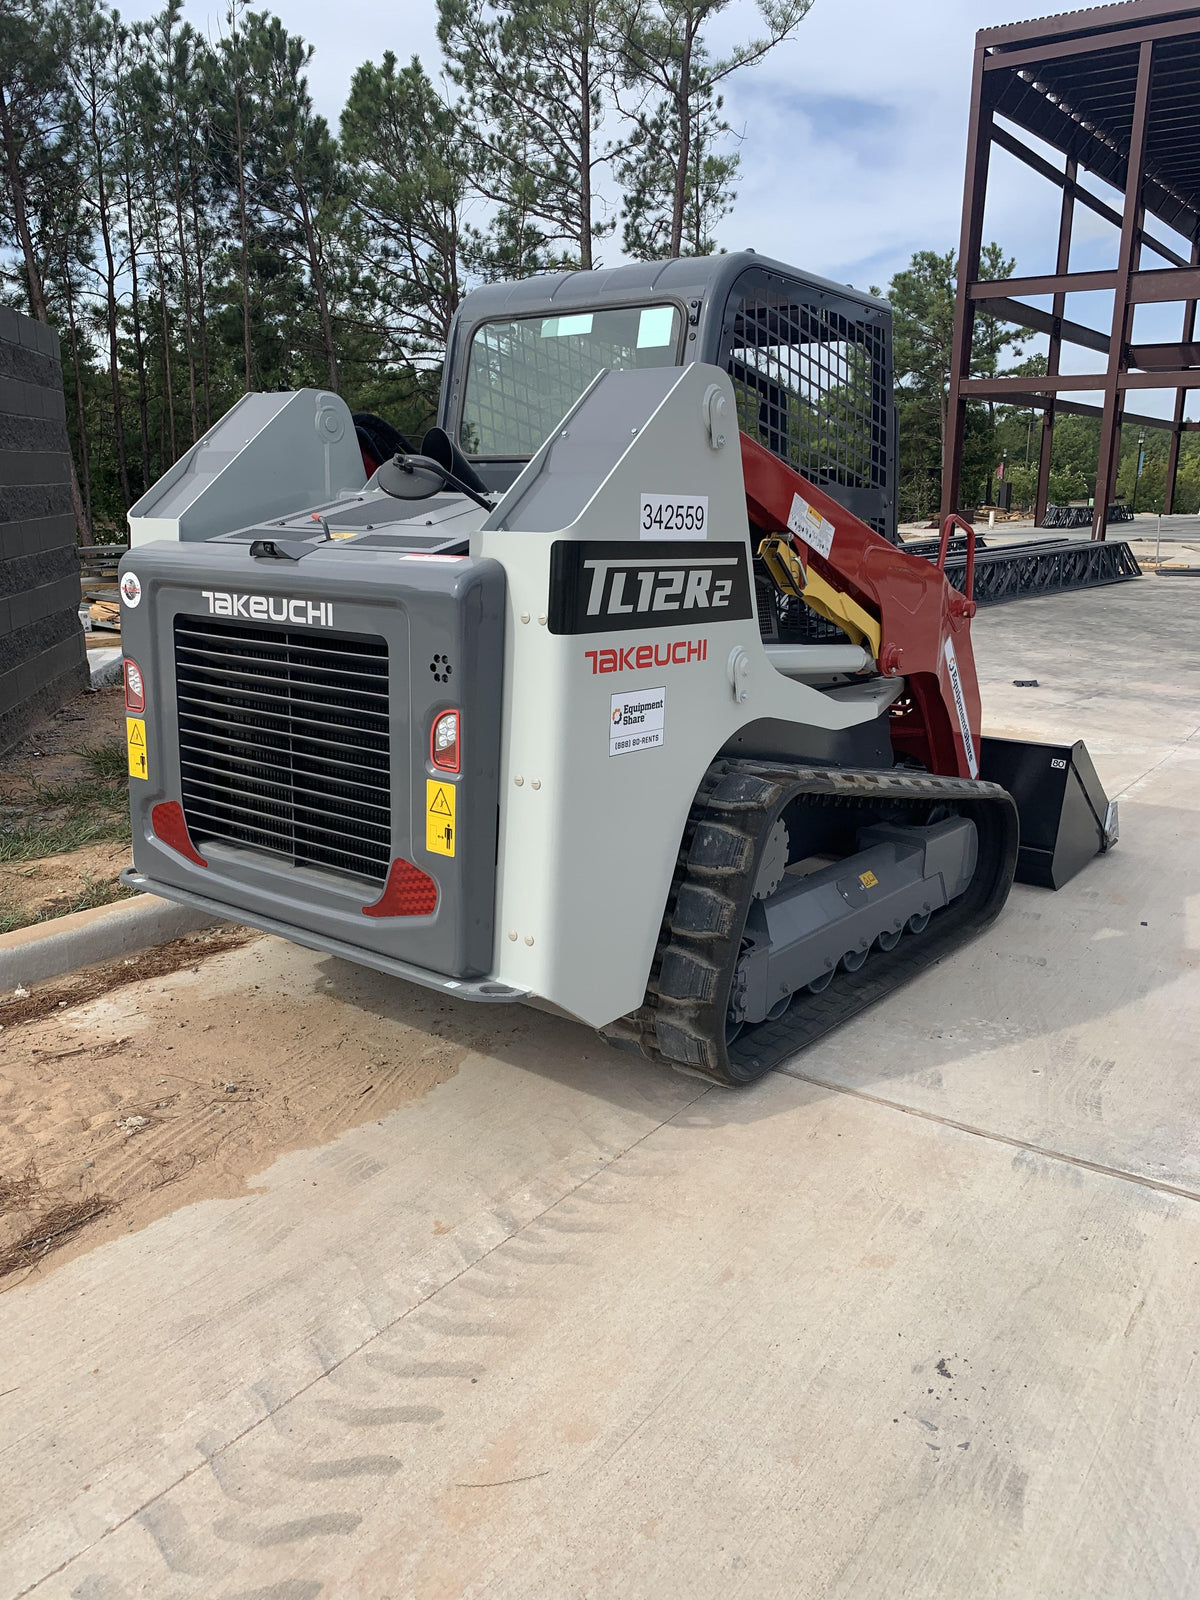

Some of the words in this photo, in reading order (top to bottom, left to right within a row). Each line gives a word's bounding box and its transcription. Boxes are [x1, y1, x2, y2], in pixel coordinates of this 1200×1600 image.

[643, 504, 704, 530] 342559
[584, 558, 738, 616] TL12R2
[623, 699, 663, 715] Equipment
[623, 715, 645, 725] Share
[614, 739, 631, 750] (888)
[1052, 760, 1065, 768] 80
